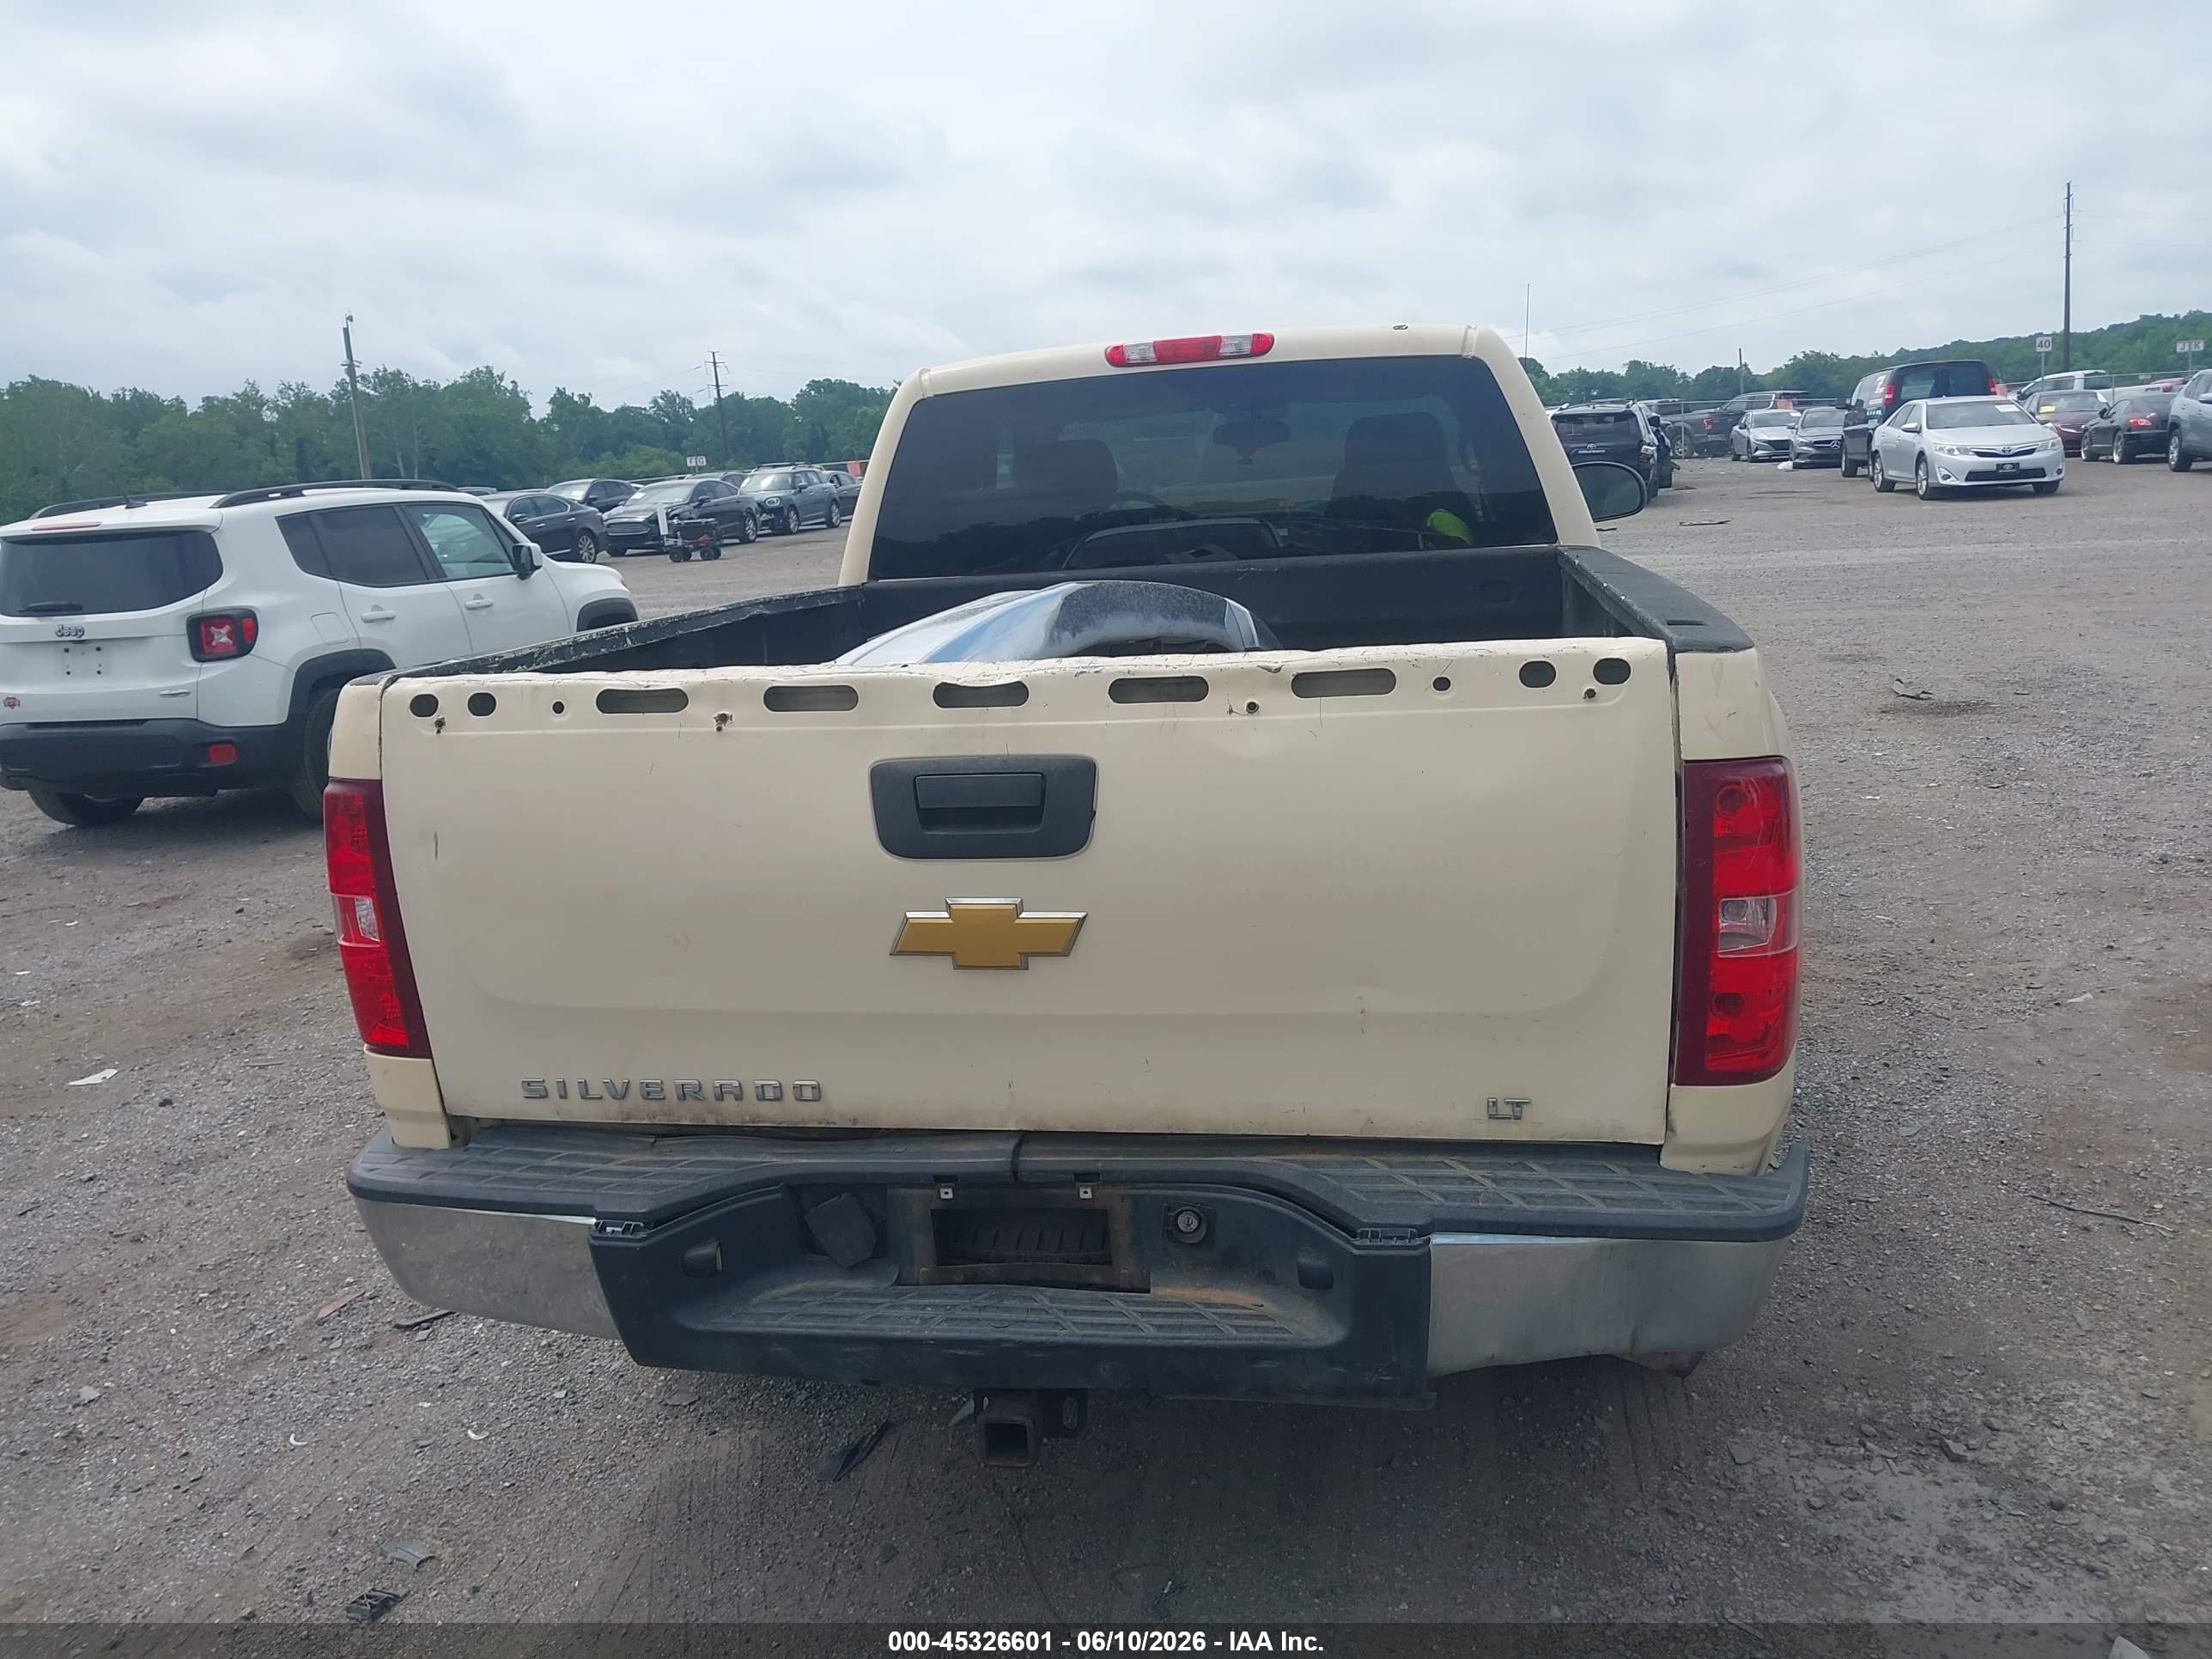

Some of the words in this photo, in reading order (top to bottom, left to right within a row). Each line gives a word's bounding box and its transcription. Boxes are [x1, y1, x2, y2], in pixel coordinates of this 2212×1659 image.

[2037, 339, 2051, 349] 40
[55, 624, 85, 639] Jeep
[520, 1077, 823, 1103] SILVERADO
[1486, 1097, 1532, 1121] LT
